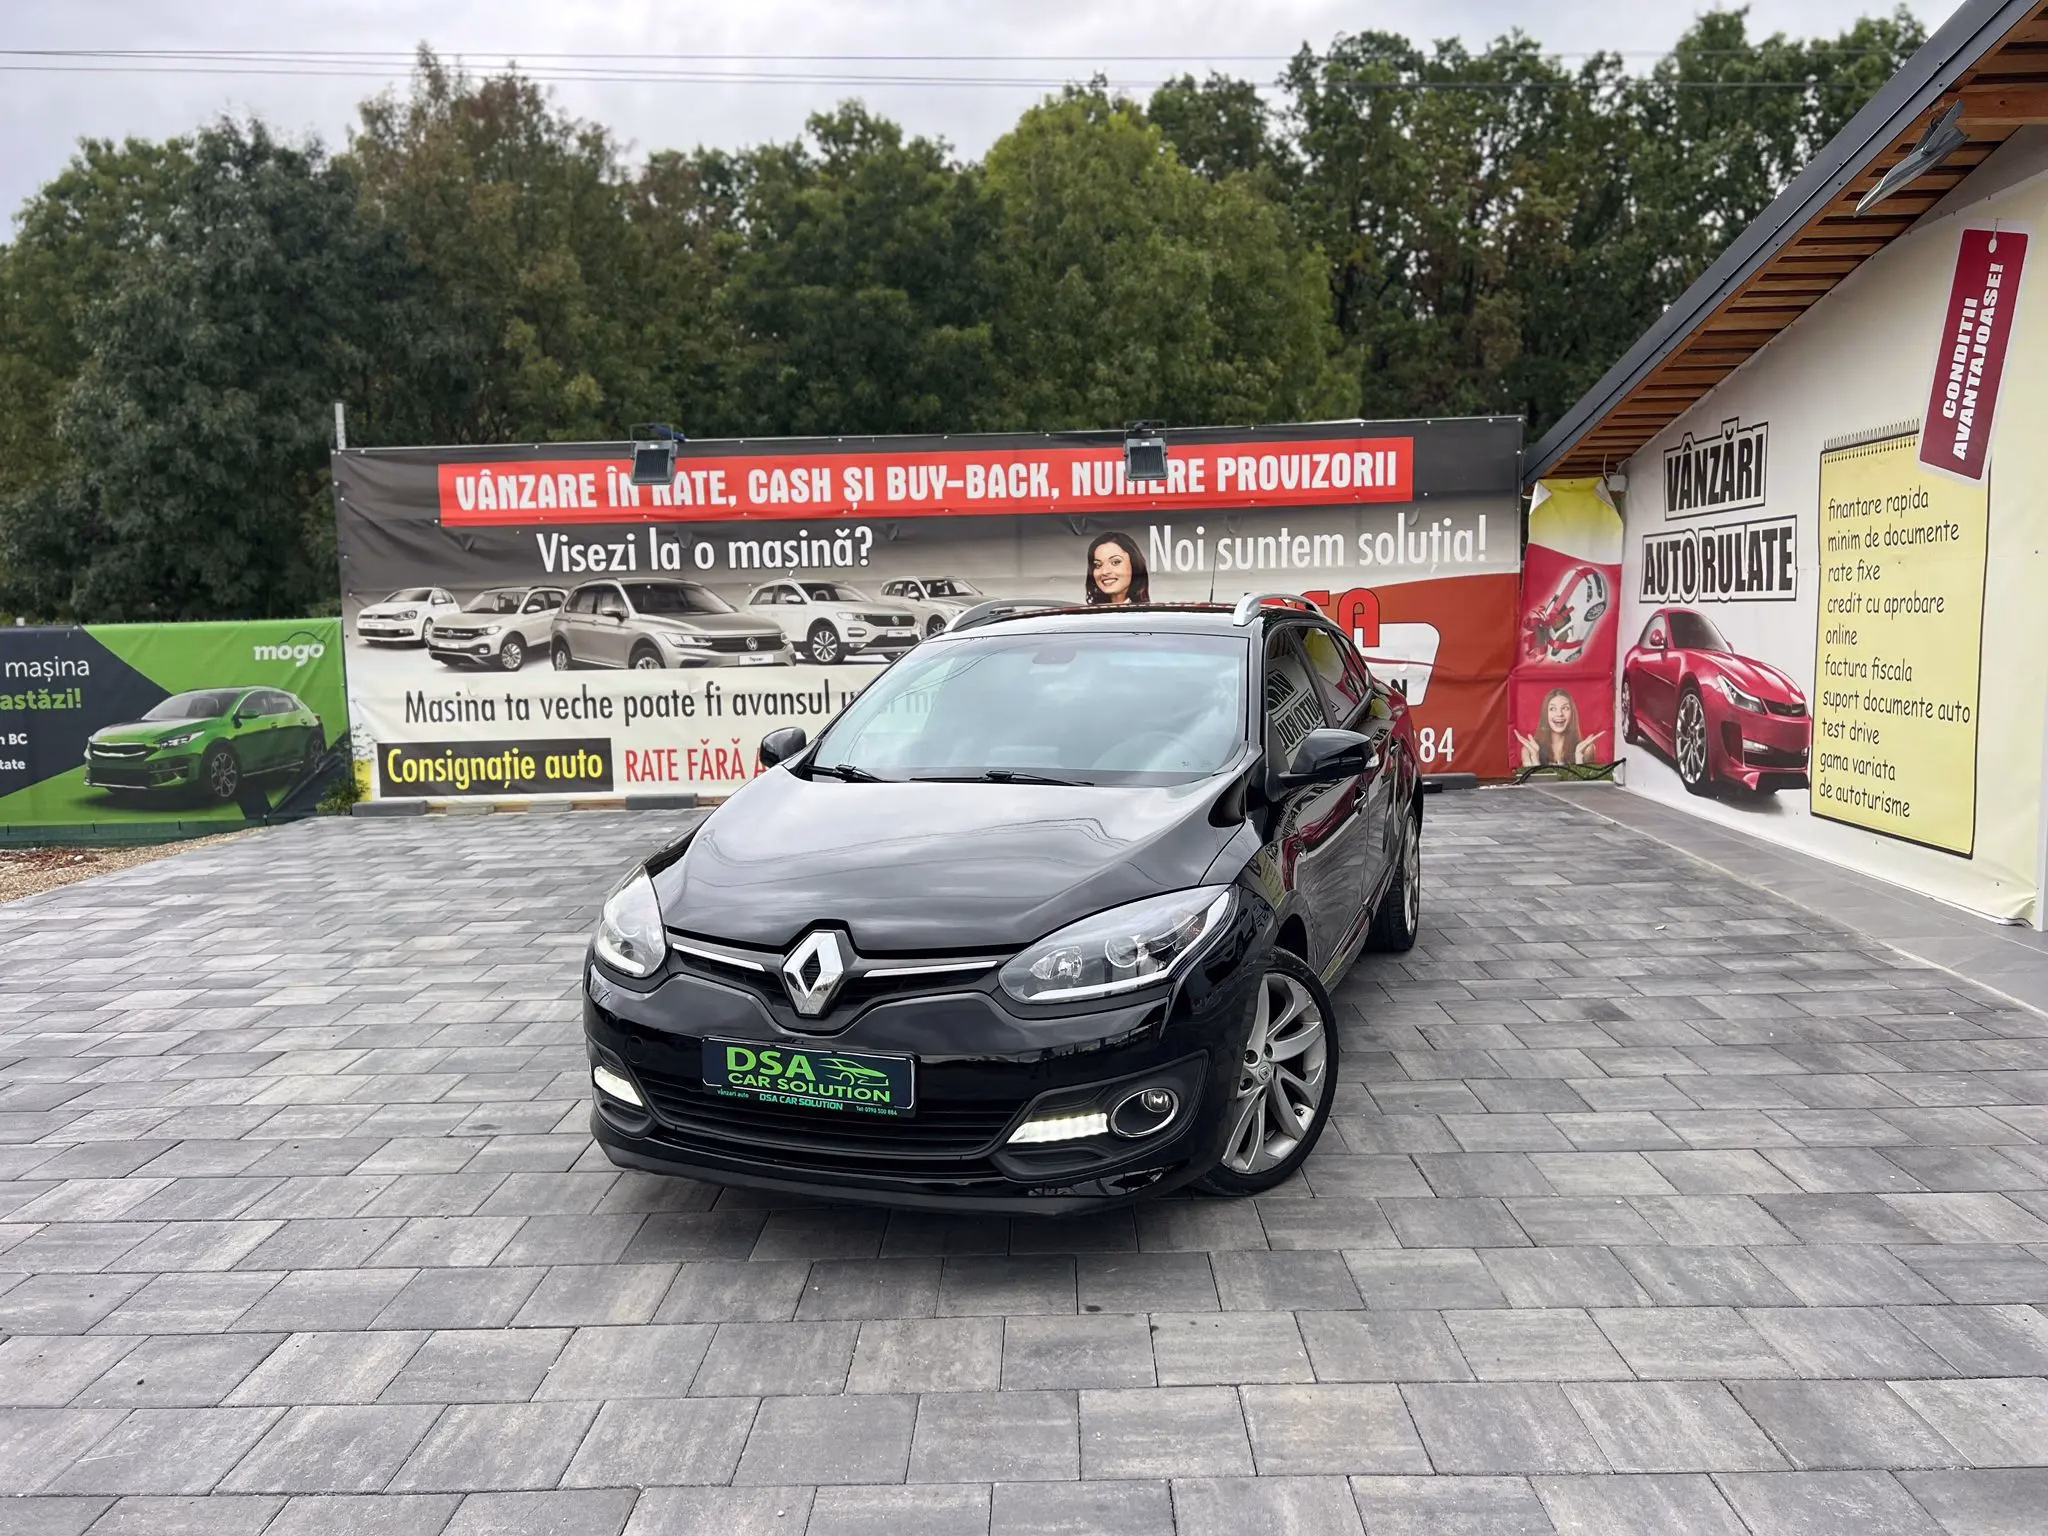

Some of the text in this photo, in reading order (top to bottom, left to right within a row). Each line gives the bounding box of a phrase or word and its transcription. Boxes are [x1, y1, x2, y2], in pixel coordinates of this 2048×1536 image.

[1942, 297, 1978, 419] CONDITII
[1953, 263, 2004, 461] AVANTAJOASE!
[455, 468, 597, 511] VÂNZARE
[749, 467, 831, 504] CASH
[843, 466, 874, 511] ȘI
[887, 462, 1060, 502] BUY-BACK,
[1217, 451, 1397, 493] PROVIZORII
[1667, 429, 1763, 512] VÂNZĂRI
[1828, 485, 1929, 521] finantare rapida
[536, 525, 874, 577] Visezi la o mașină?
[1149, 512, 1487, 575] Noi suntem soluția!
[1828, 520, 1960, 552] minim de documente
[1643, 526, 1793, 595] AUTO RULATE
[1828, 558, 1881, 582] rate fixe
[1828, 590, 1945, 620] credit cu aprobare
[1826, 623, 1858, 645] online
[5, 656, 90, 682] mașina
[253, 643, 325, 668] mogo
[1825, 654, 1912, 682] factura fiscala
[405, 690, 496, 724] Masina
[504, 692, 530, 721] ta
[539, 684, 613, 720] veche
[624, 689, 695, 727] poate
[704, 681, 722, 717] fi
[732, 679, 830, 717] avansul
[1823, 689, 1970, 723] suport documente auto
[8, 733, 28, 745] BC
[1413, 727, 1454, 763] 84
[1822, 718, 1880, 745] test drive
[387, 747, 536, 791] Consignație
[545, 749, 603, 779] auto
[625, 748, 680, 782] RATE
[686, 738, 746, 781] FĂRĂ
[1820, 752, 1896, 781] gama variata
[1819, 777, 1911, 818] de autoturisme
[726, 1046, 816, 1081] DSA
[728, 1073, 891, 1103] CAR SOLUTION
[759, 1093, 844, 1110] DSA CAR SOLUTION
